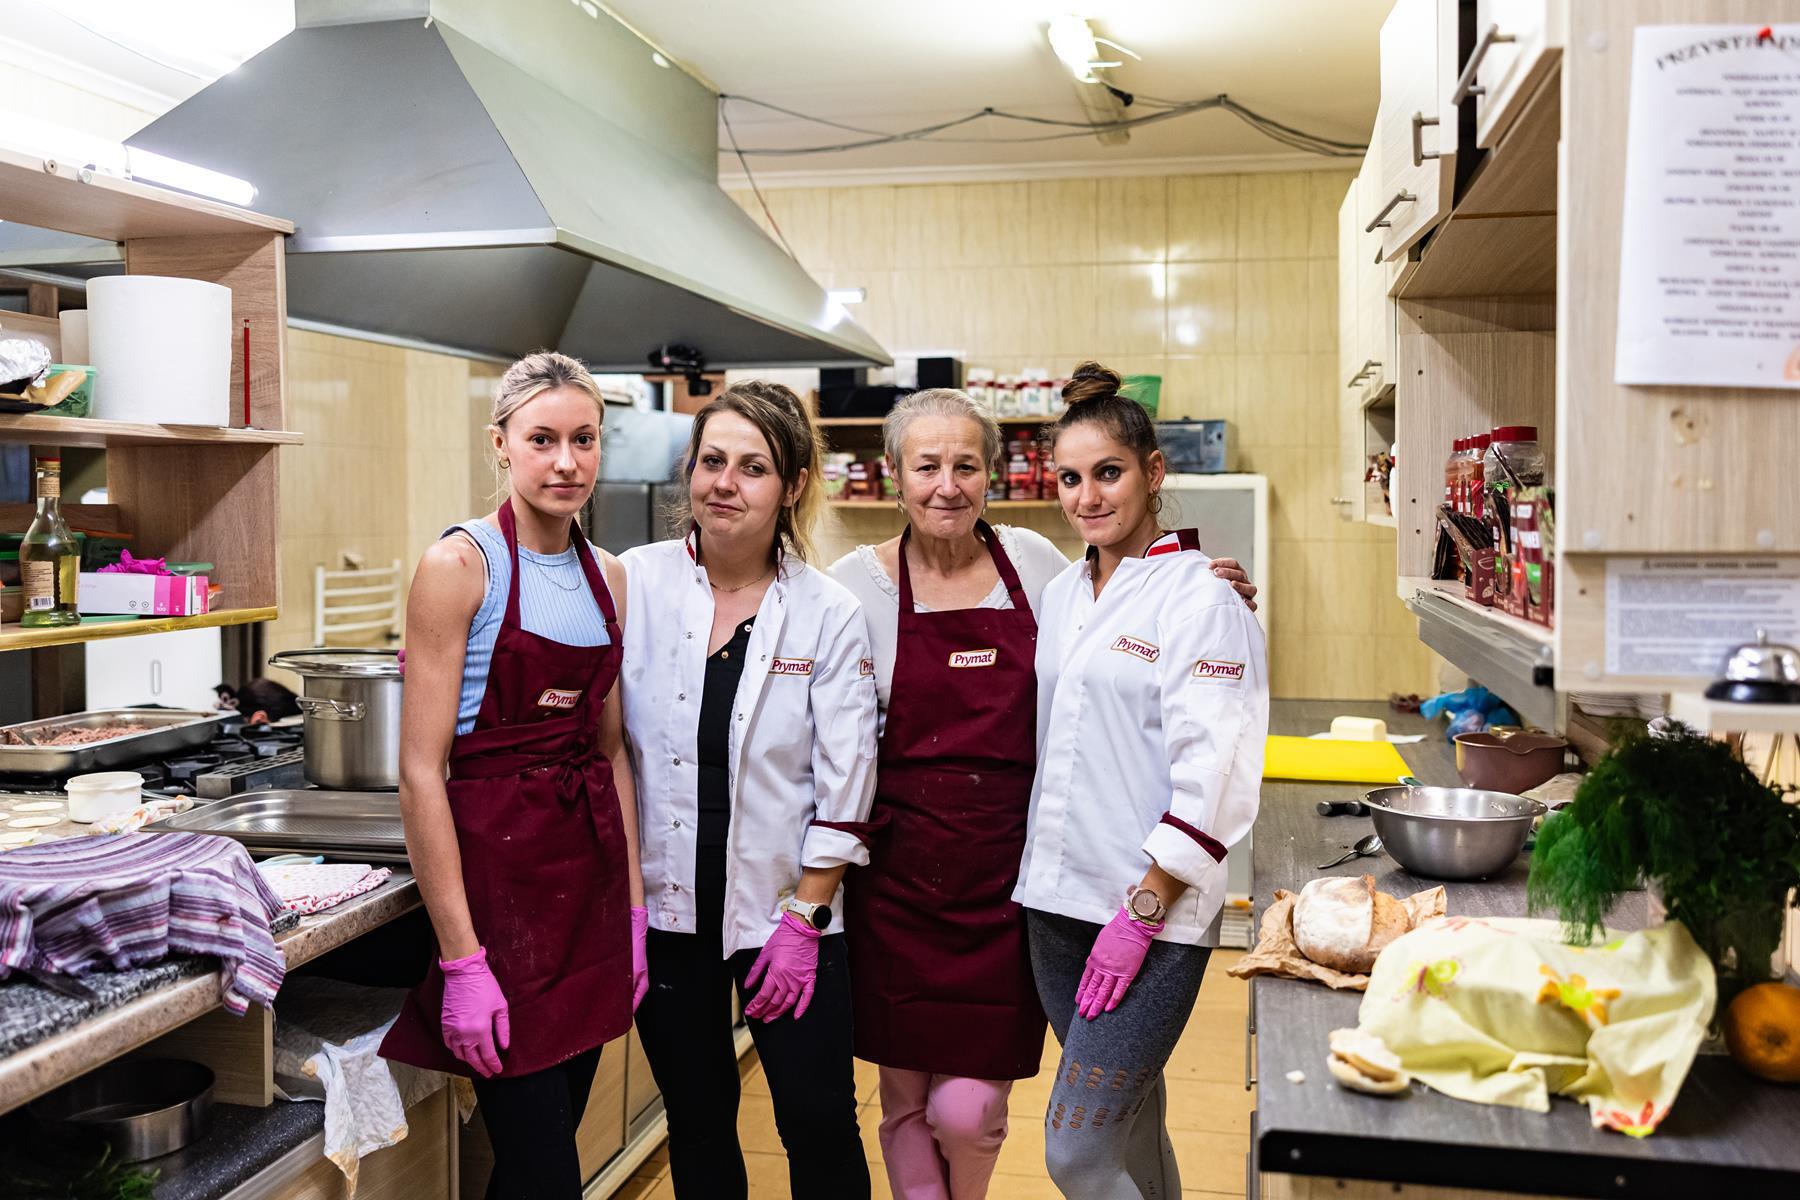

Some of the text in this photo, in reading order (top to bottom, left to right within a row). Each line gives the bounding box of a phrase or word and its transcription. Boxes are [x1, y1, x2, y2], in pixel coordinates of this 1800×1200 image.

[1116, 637, 1156, 659] Prymat
[771, 659, 812, 674] Prymat
[954, 652, 993, 667] Prymat
[1199, 662, 1241, 677] Prymat
[545, 692, 577, 707] Pryma
